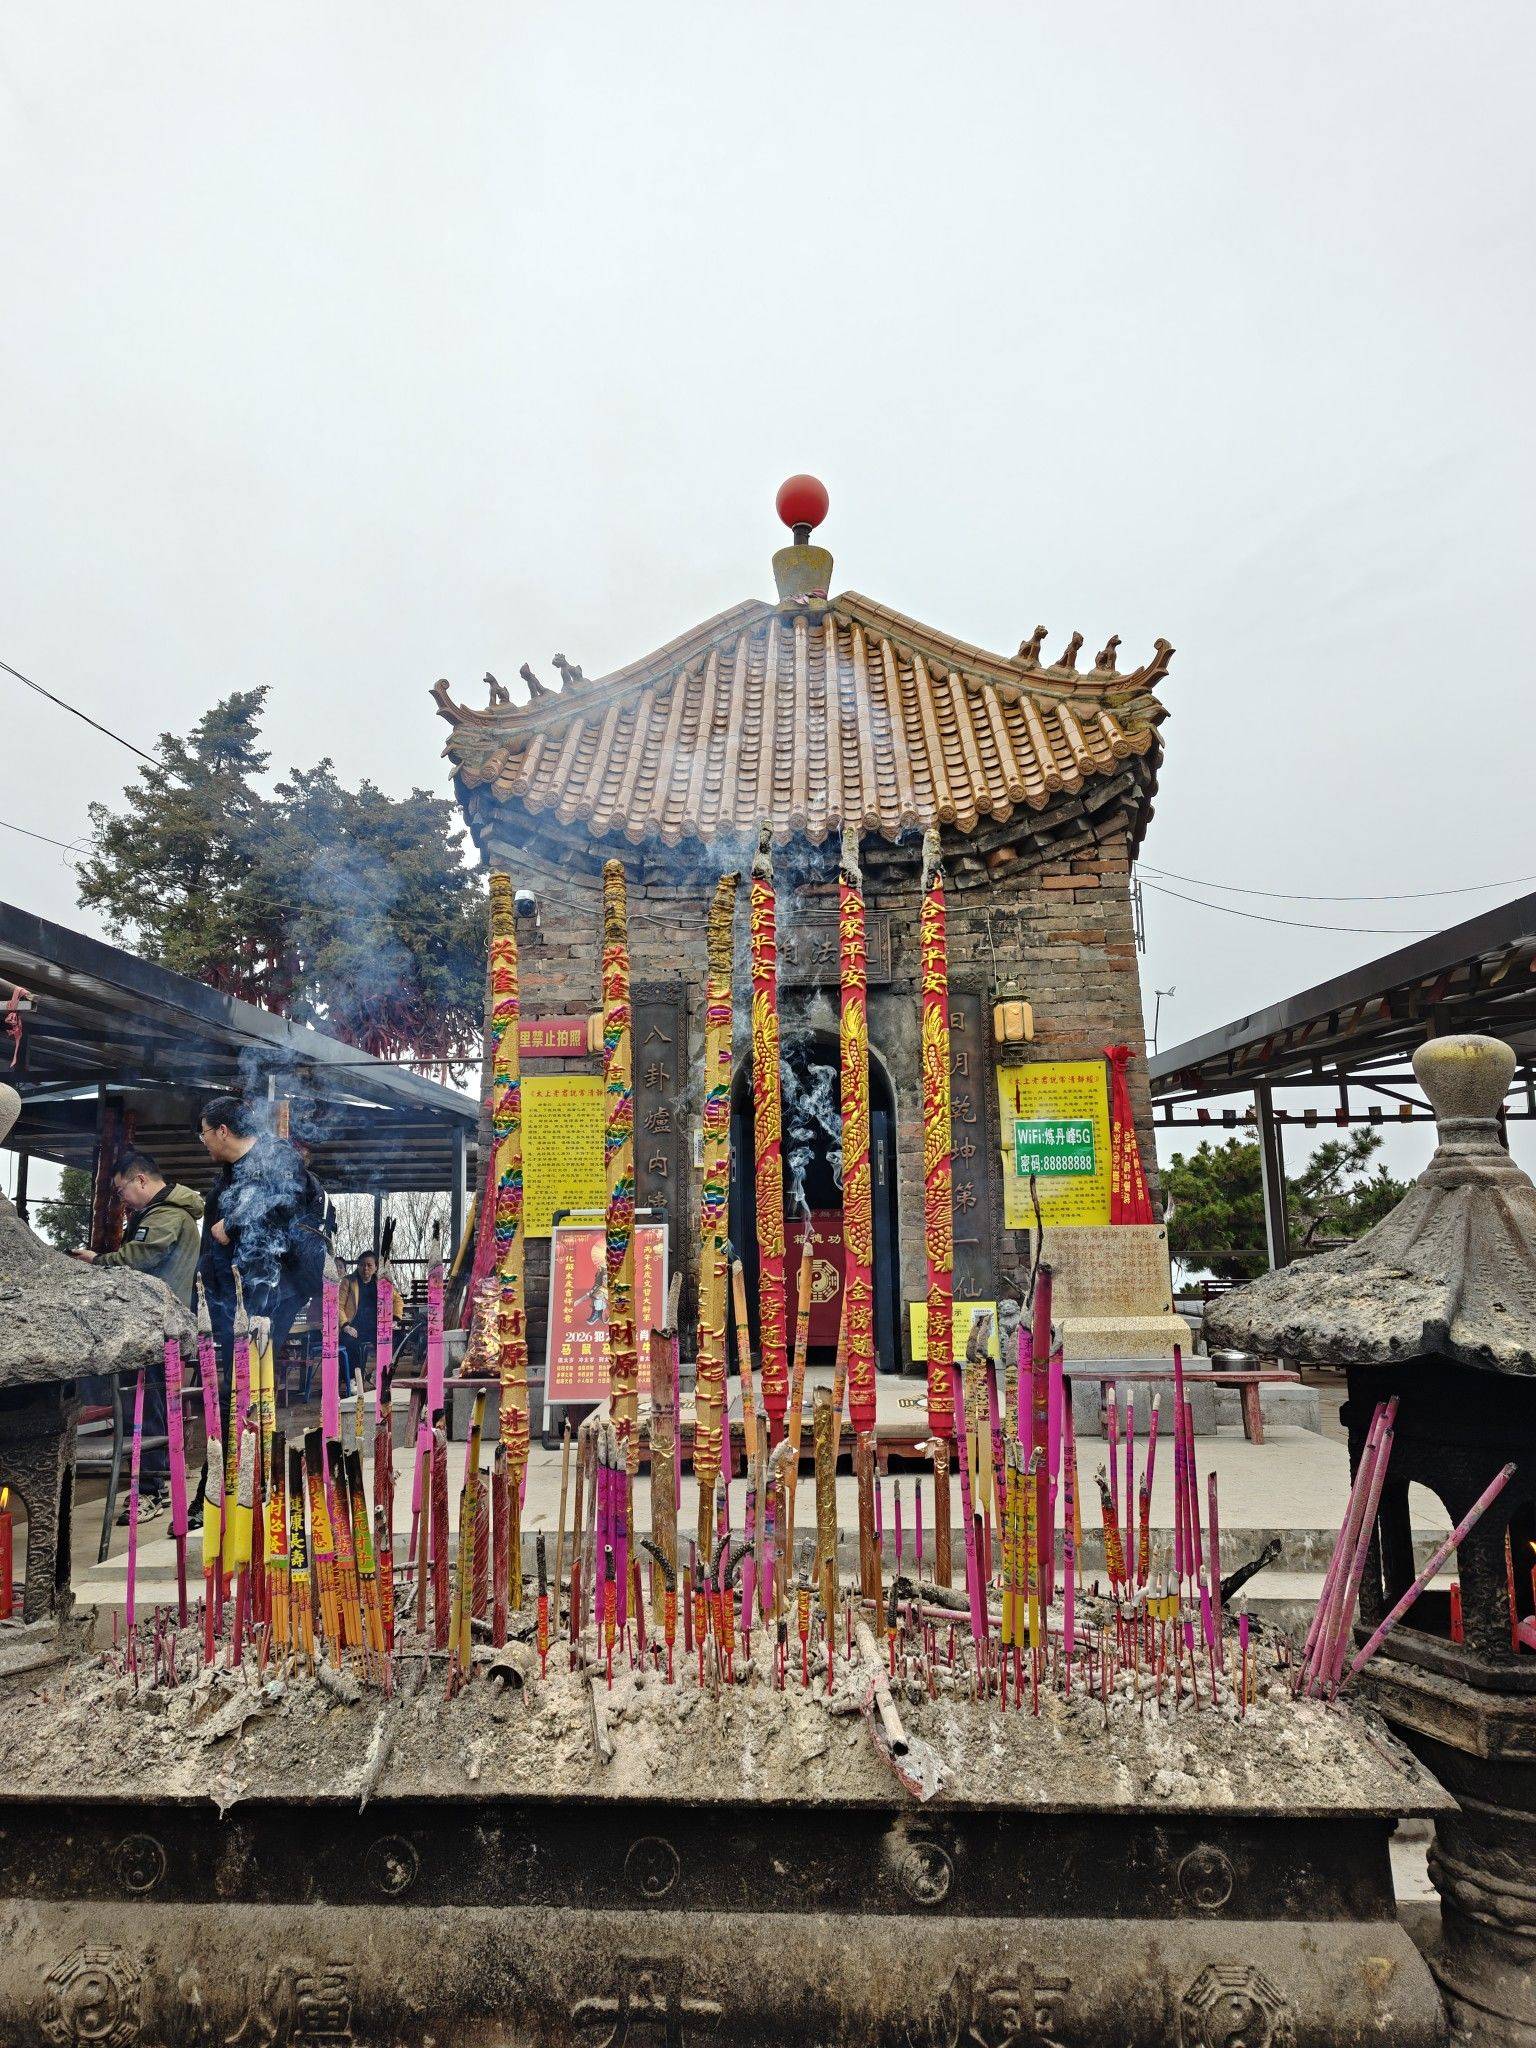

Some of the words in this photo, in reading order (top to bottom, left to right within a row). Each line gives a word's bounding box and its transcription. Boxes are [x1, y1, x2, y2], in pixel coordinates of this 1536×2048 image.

[750, 883, 776, 981] 合家平安
[839, 891, 867, 990] 合家平安
[919, 896, 948, 995] 合家平安
[1020, 1154, 1092, 1173] 密码:88888888
[565, 1331, 592, 1343] 2026
[845, 1276, 875, 1386] 金榜题名
[926, 1282, 954, 1396] 金榜题名
